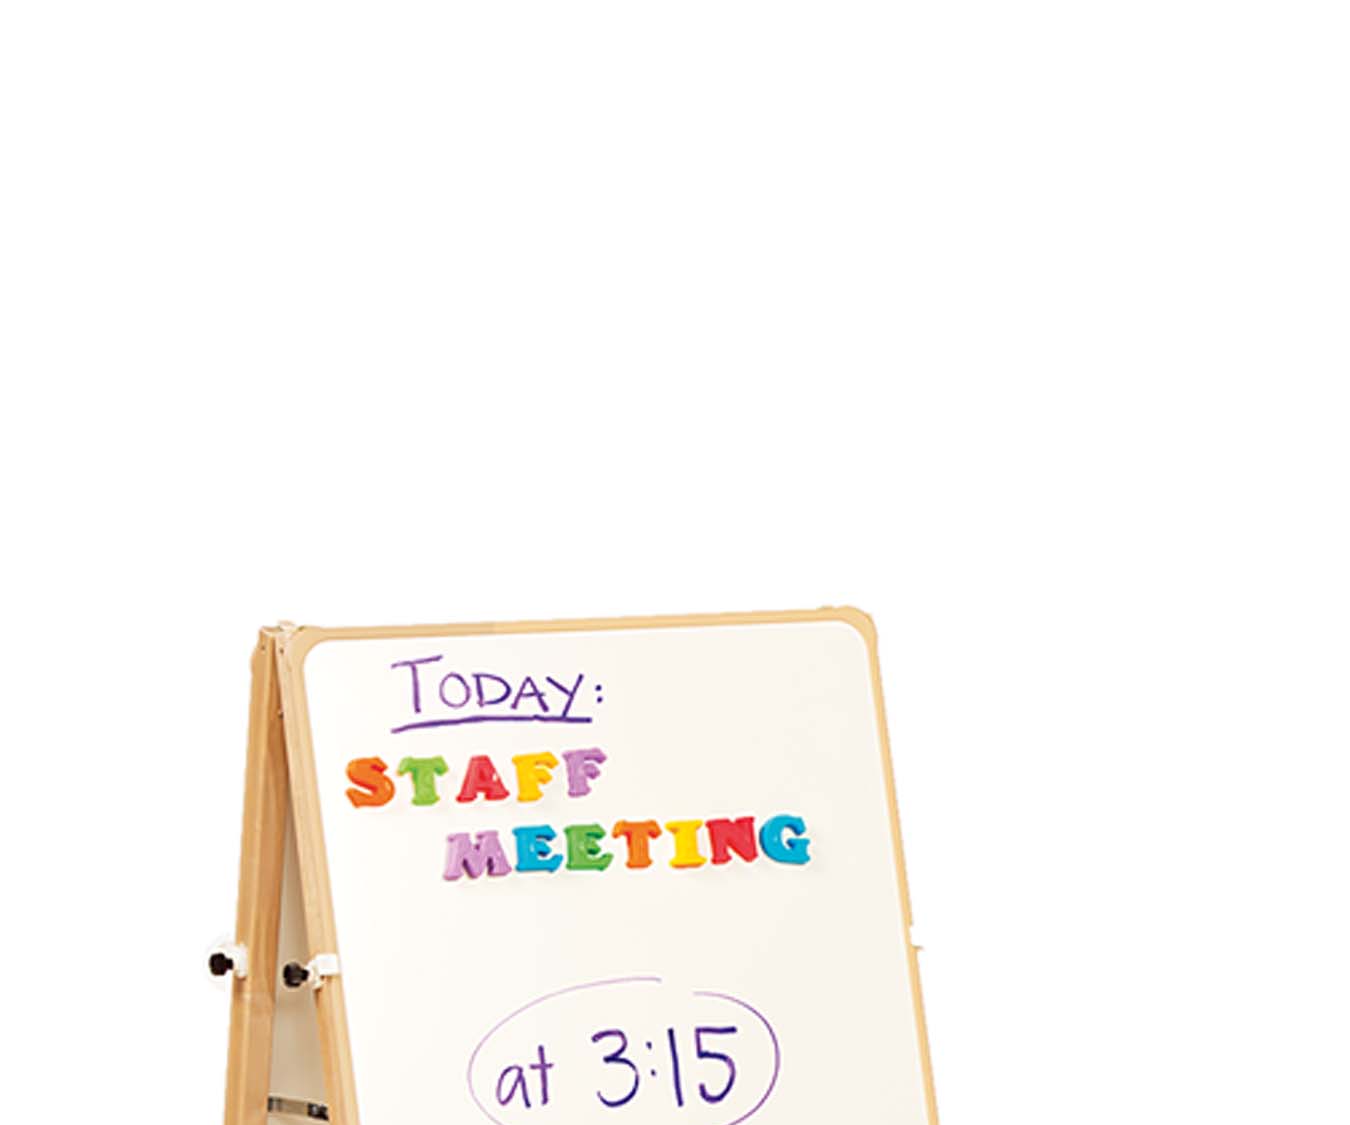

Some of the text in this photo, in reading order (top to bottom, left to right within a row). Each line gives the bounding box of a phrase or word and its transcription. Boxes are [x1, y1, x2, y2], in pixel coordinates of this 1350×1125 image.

[391, 654, 605, 720] TODAY:
[344, 747, 607, 808] STAFF
[443, 814, 812, 881] MEETING
[495, 1026, 738, 1109] at 3:15
